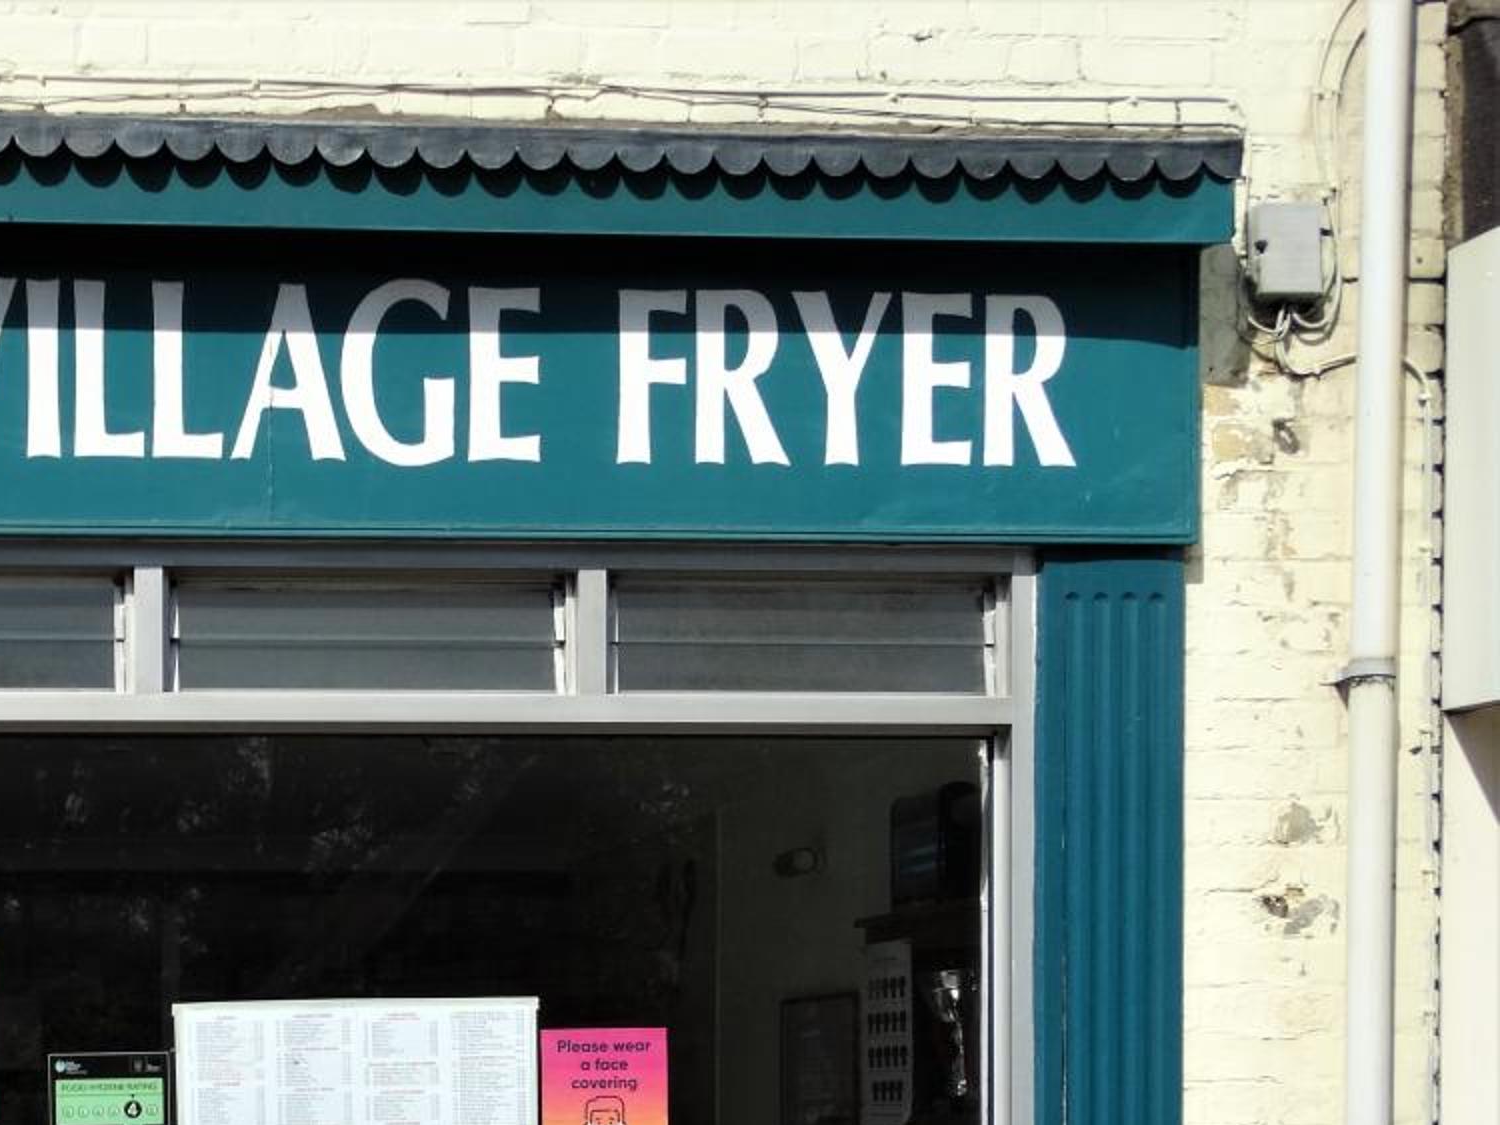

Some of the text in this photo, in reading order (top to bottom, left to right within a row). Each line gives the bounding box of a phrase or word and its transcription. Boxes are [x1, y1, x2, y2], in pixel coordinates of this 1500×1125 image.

[616, 287, 1078, 468] FRYER
[557, 1039, 652, 1053] Please wear
[580, 1058, 629, 1071] a face
[571, 1076, 638, 1092] covering
